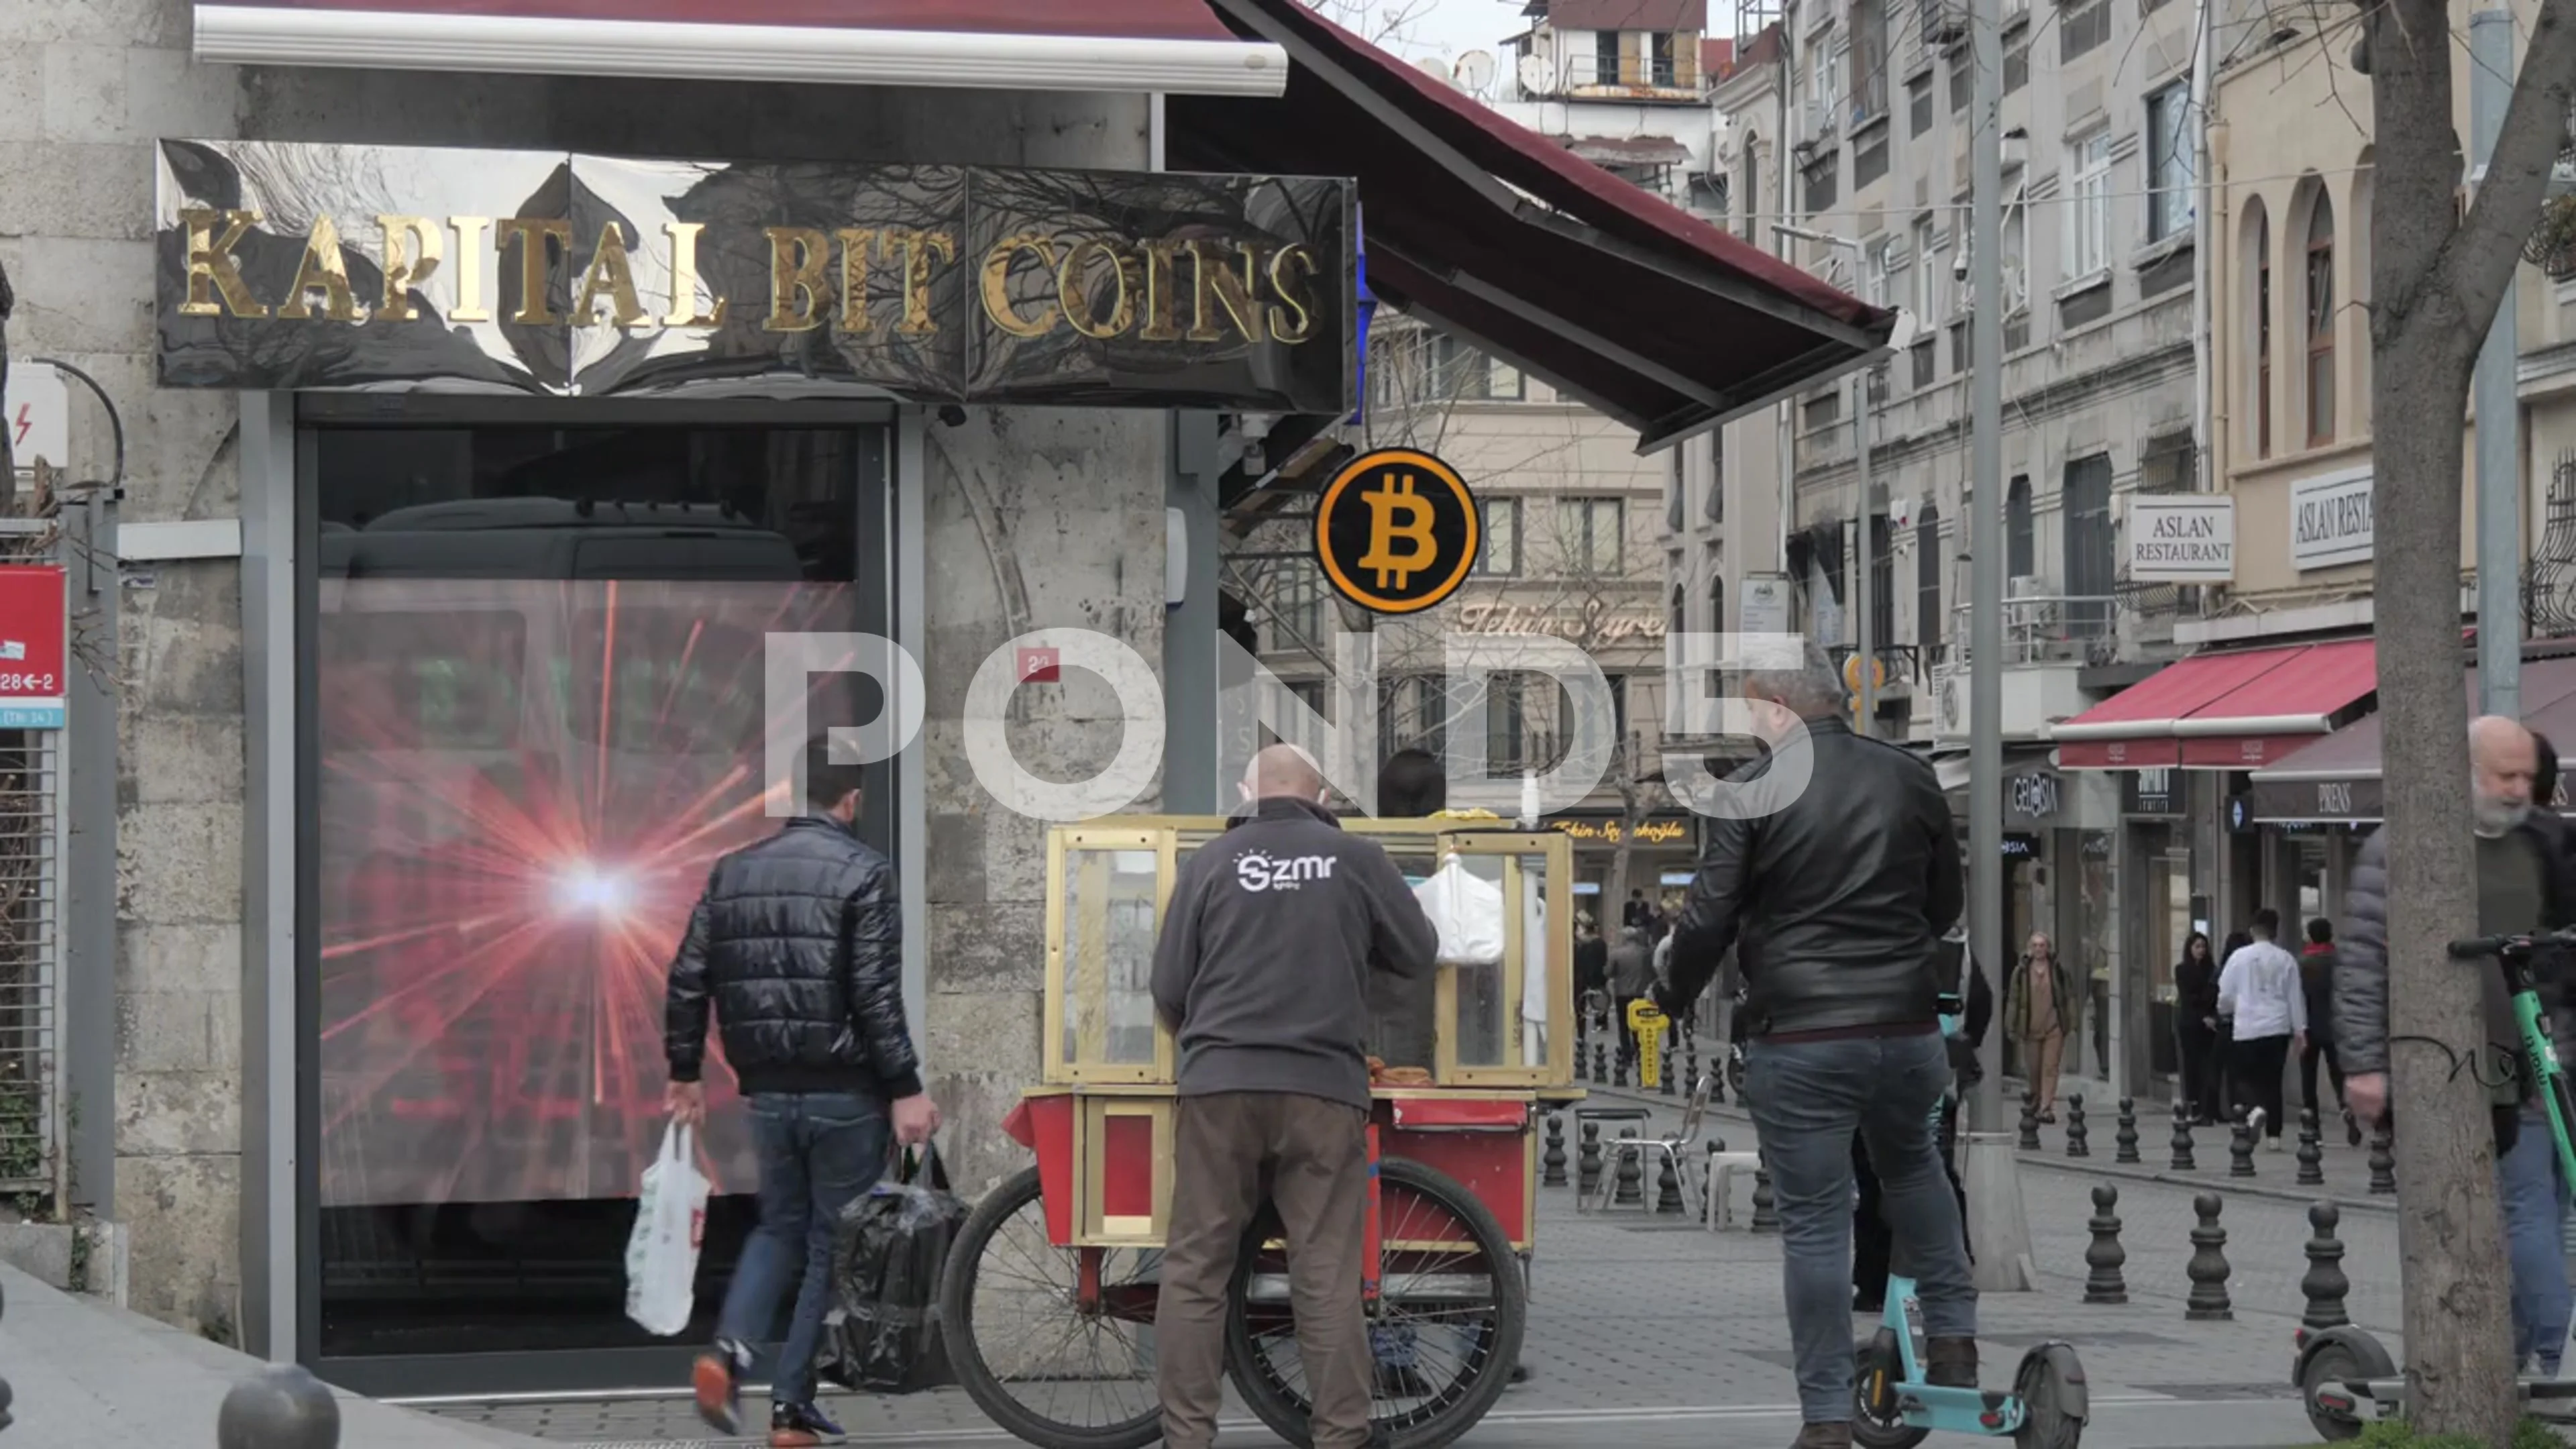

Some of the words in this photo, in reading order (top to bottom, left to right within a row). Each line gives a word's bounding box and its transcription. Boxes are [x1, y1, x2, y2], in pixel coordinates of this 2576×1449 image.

[178, 209, 727, 329] KAPITAL
[763, 226, 955, 336] BIT
[979, 231, 1322, 344] COINS
[2153, 516, 2214, 539] ASLAN
[2296, 498, 2335, 544] ASLAN
[2337, 490, 2373, 537] RESTA
[2136, 543, 2231, 561] RESTAURANT
[1551, 820, 1595, 838] Tkin
[1238, 855, 1337, 892] Szmr
